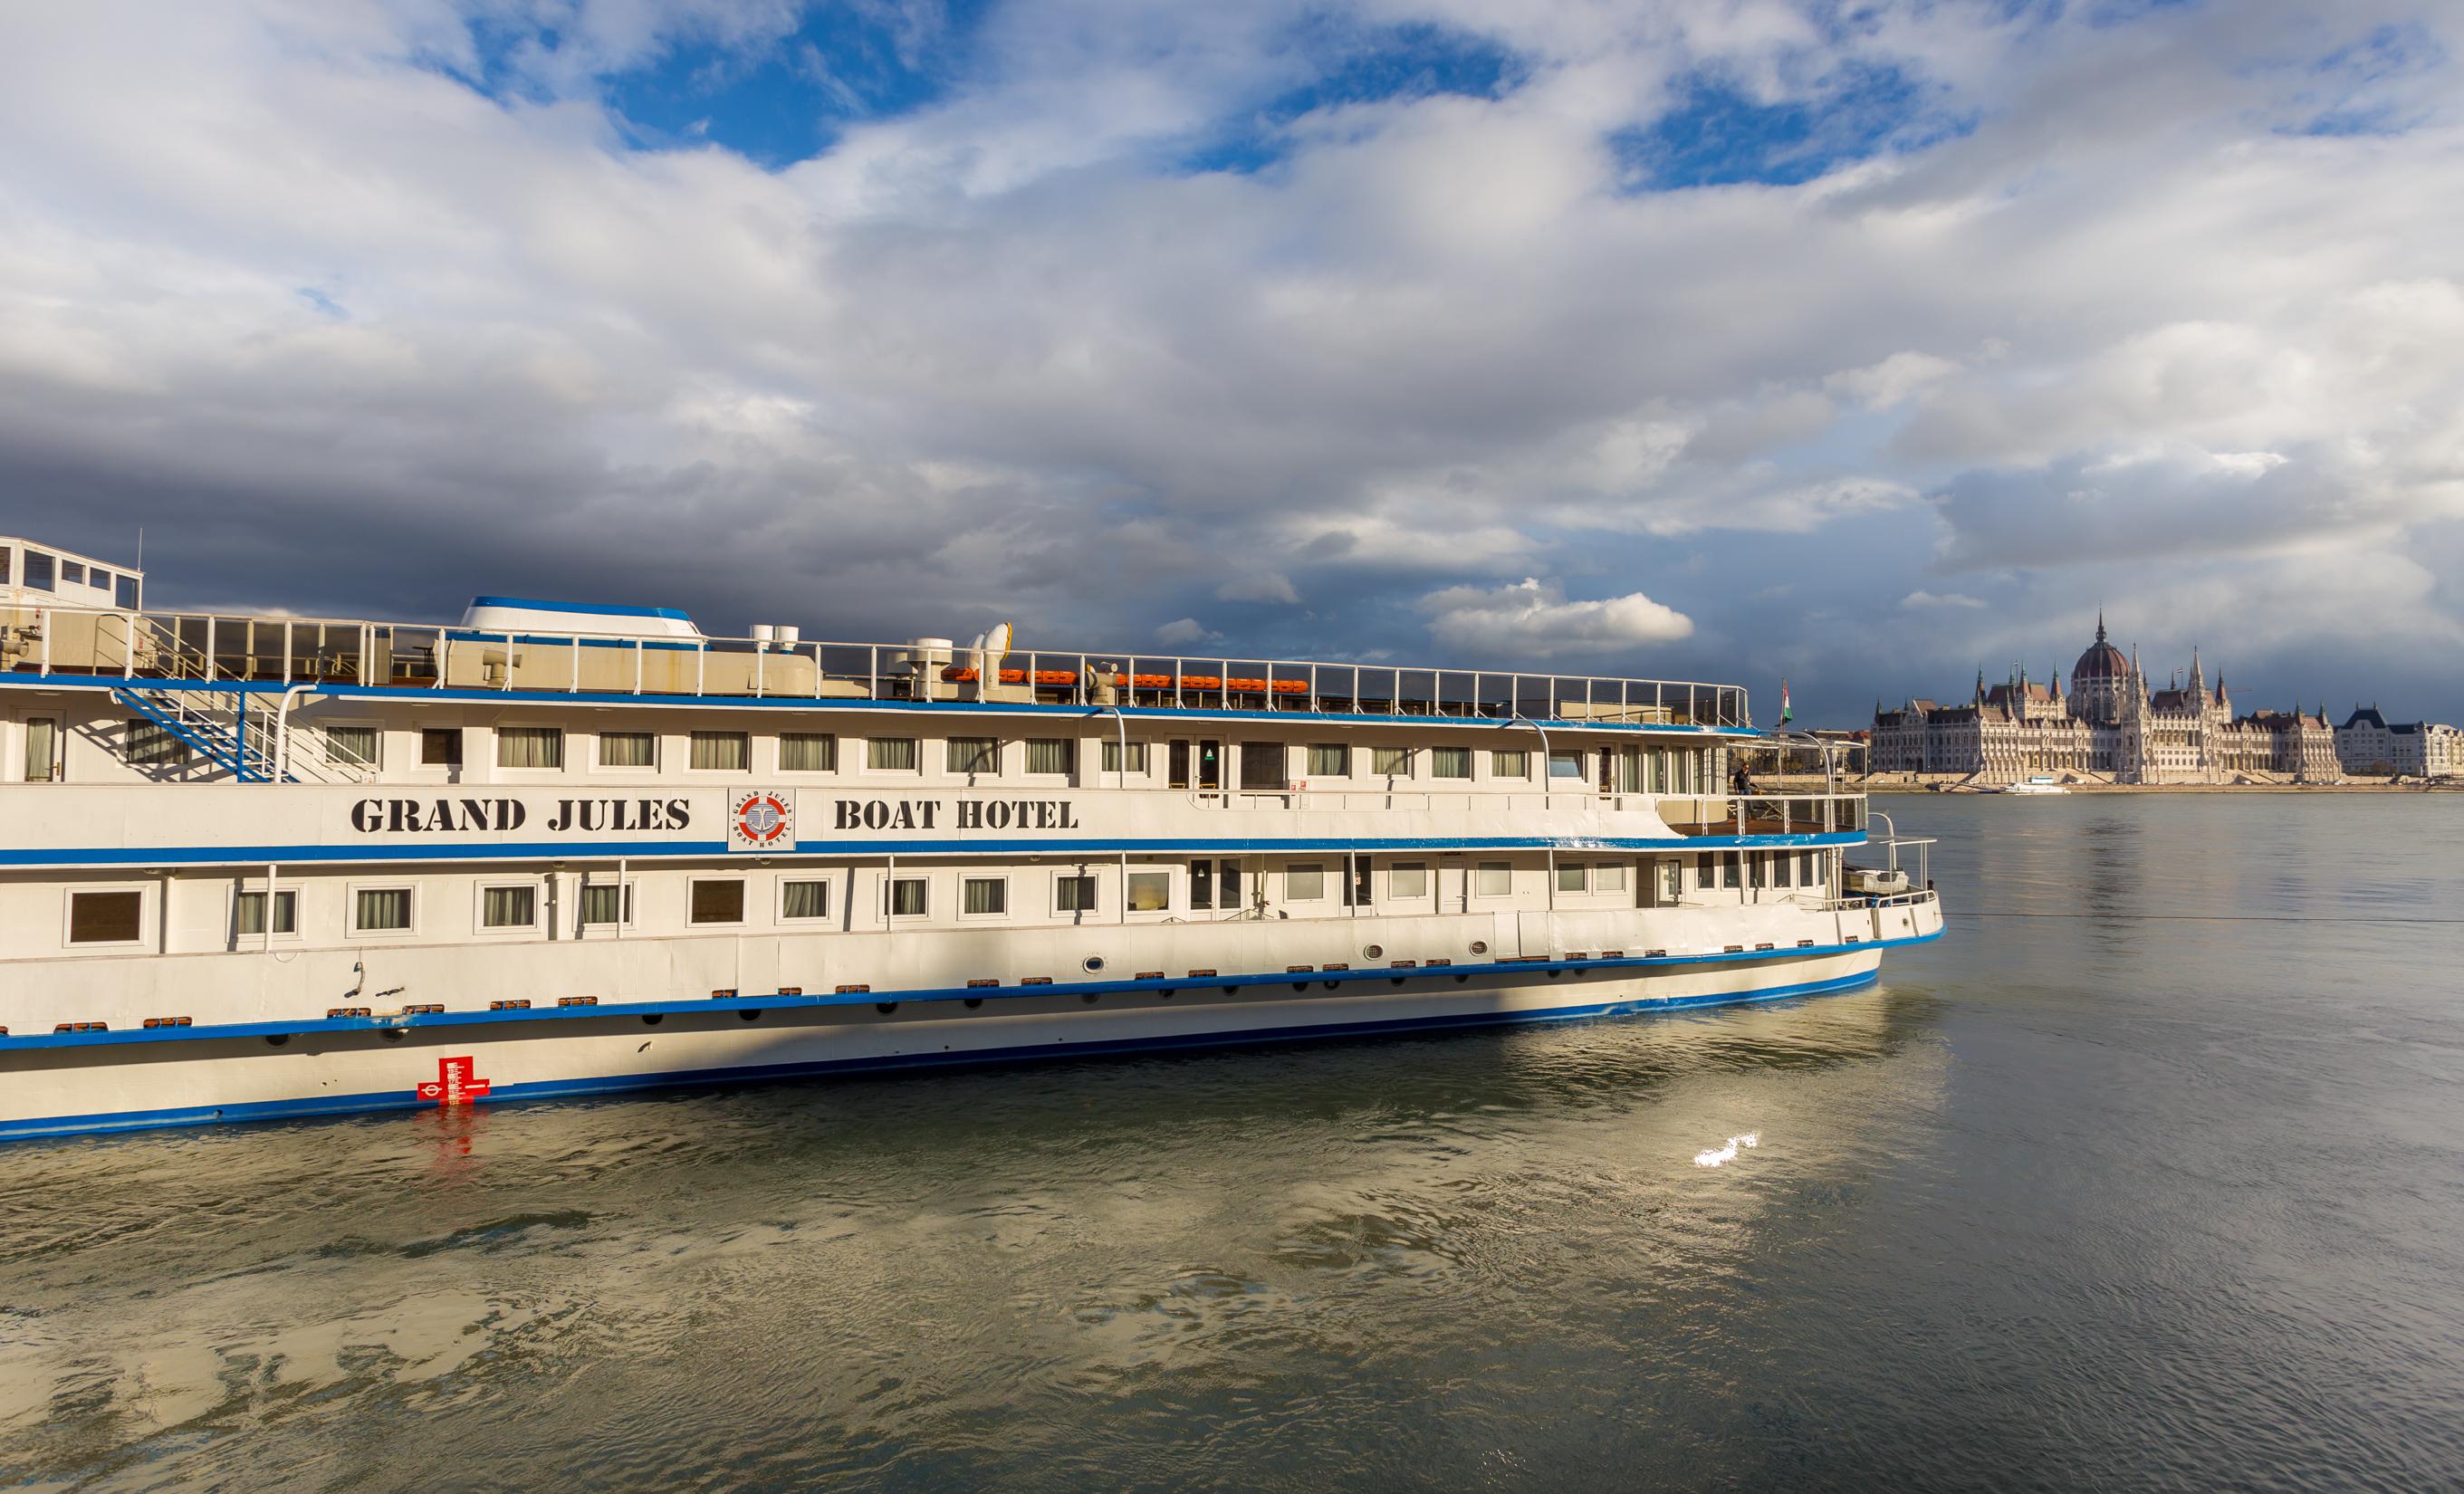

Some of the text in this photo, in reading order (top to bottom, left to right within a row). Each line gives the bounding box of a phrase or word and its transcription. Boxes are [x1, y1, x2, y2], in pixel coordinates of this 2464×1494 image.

[733, 790, 792, 814] GRAND JULES
[834, 800, 1079, 829] BOAT HOTEL
[351, 799, 690, 833] GRAND JULES
[733, 826, 791, 848] BOAT HOTEL
